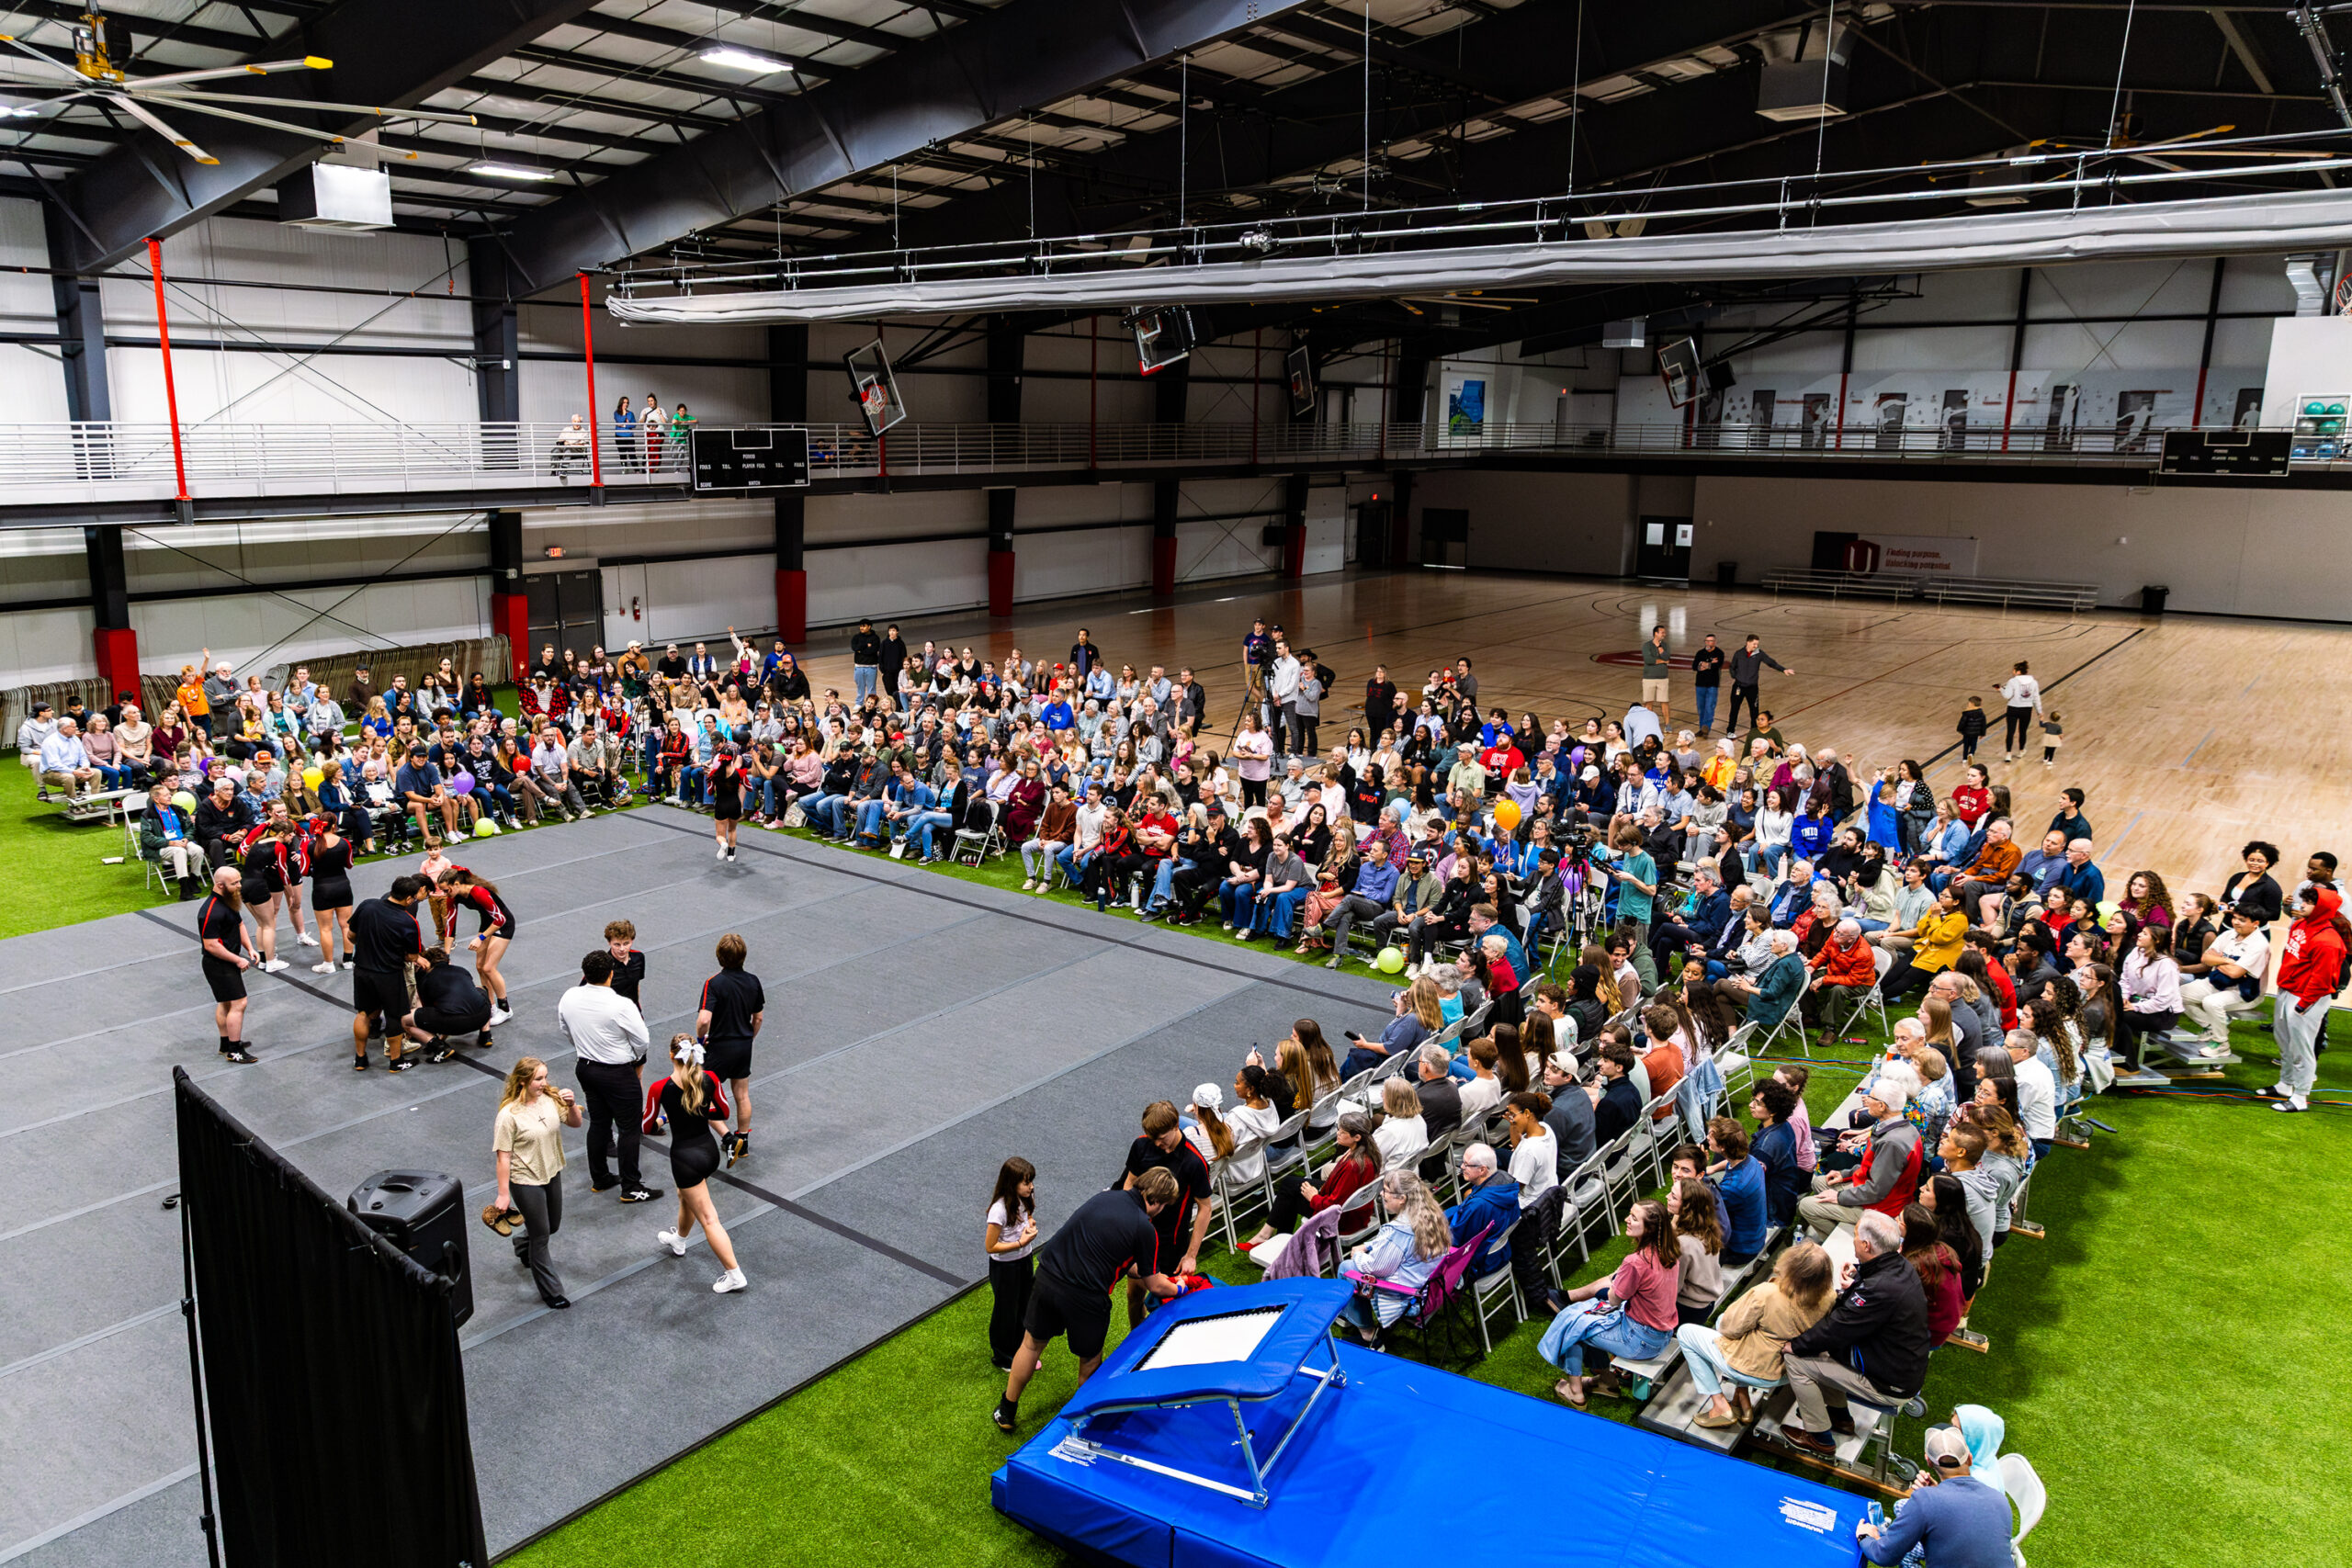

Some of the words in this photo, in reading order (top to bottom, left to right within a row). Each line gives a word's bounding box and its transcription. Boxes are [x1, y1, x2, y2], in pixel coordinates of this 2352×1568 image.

[1885, 558, 1918, 570] Unlocking
[1359, 793, 1377, 805] NASA
[1801, 827, 1818, 837] UNIO
